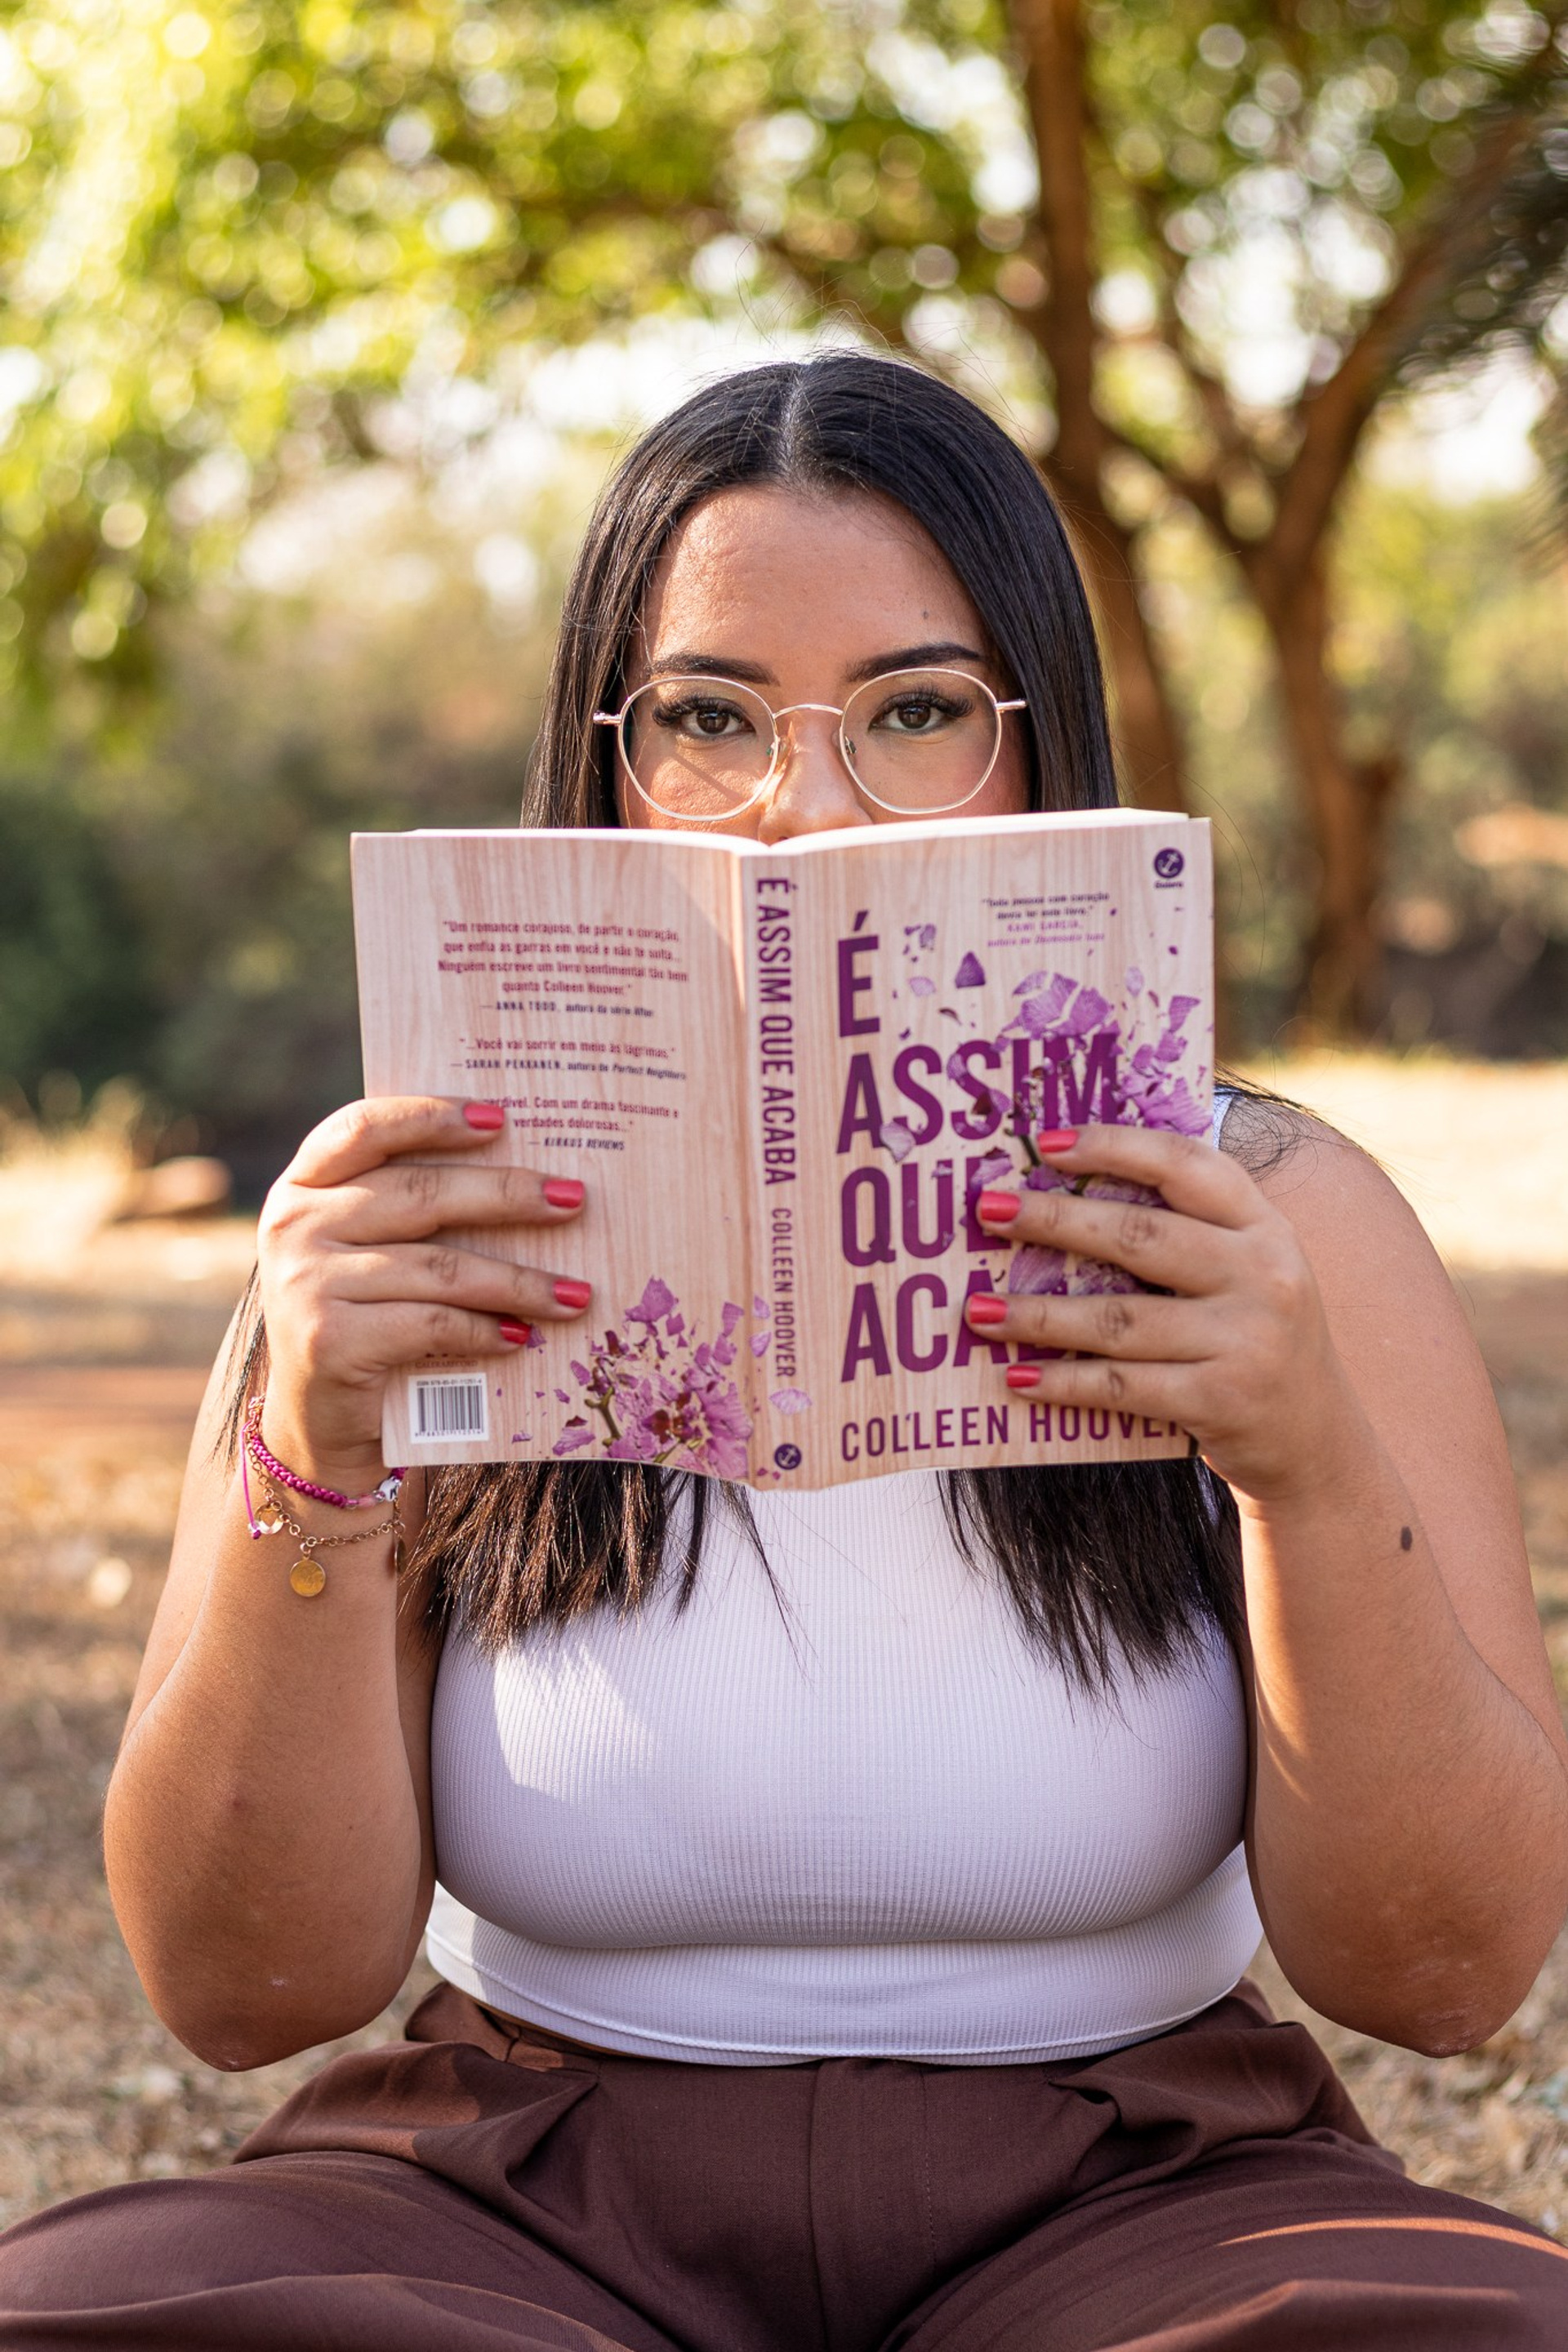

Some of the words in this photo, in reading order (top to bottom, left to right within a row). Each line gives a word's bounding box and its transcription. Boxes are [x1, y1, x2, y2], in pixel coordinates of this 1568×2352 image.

[755, 878, 798, 894] É
[471, 923, 520, 933] romance
[577, 923, 590, 934] de
[594, 924, 623, 937] partir
[443, 942, 464, 954] que
[468, 941, 496, 952] enfia
[500, 942, 511, 952] as
[515, 942, 552, 955] garras
[555, 943, 571, 953] em
[575, 942, 599, 954] você
[614, 943, 631, 956] não
[635, 946, 644, 957] te
[757, 905, 793, 1004] ASSIM
[438, 960, 486, 973] Ninguém
[489, 962, 534, 972] escreve
[537, 962, 554, 972] um
[557, 961, 581, 973] livro
[585, 964, 645, 978] sentimental
[648, 967, 664, 979] tão
[667, 969, 688, 982] bem
[838, 910, 880, 1038] É
[502, 981, 541, 993] quanto
[544, 980, 585, 992] Colleen
[496, 1000, 524, 1011] ANNA
[566, 1003, 595, 1013] autora
[597, 1004, 608, 1014] da
[611, 1005, 631, 1015] série
[506, 1040, 523, 1049] vai
[526, 1040, 557, 1050] sorrir
[560, 1041, 577, 1051] em
[580, 1041, 606, 1053] meio
[760, 1015, 794, 1075] QUE
[466, 1059, 501, 1069] SARAH
[567, 1062, 596, 1071] autora
[599, 1062, 609, 1072] de
[836, 1032, 1120, 1154] ASSIM
[534, 1097, 559, 1108] Com
[561, 1099, 578, 1109] um
[581, 1098, 615, 1111] drama
[618, 1100, 670, 1116] fascinante
[673, 1109, 679, 1119] e
[514, 1116, 564, 1128] verdades
[545, 1137, 582, 1147] KIRKUS
[586, 1138, 625, 1151] REVIEWS
[763, 1086, 797, 1186] ACABA
[771, 1207, 794, 1293] COLLEEN
[840, 1268, 1102, 1383] ACA
[774, 1301, 796, 1378] HOOVER
[841, 1405, 1009, 1462] COLLEEN
